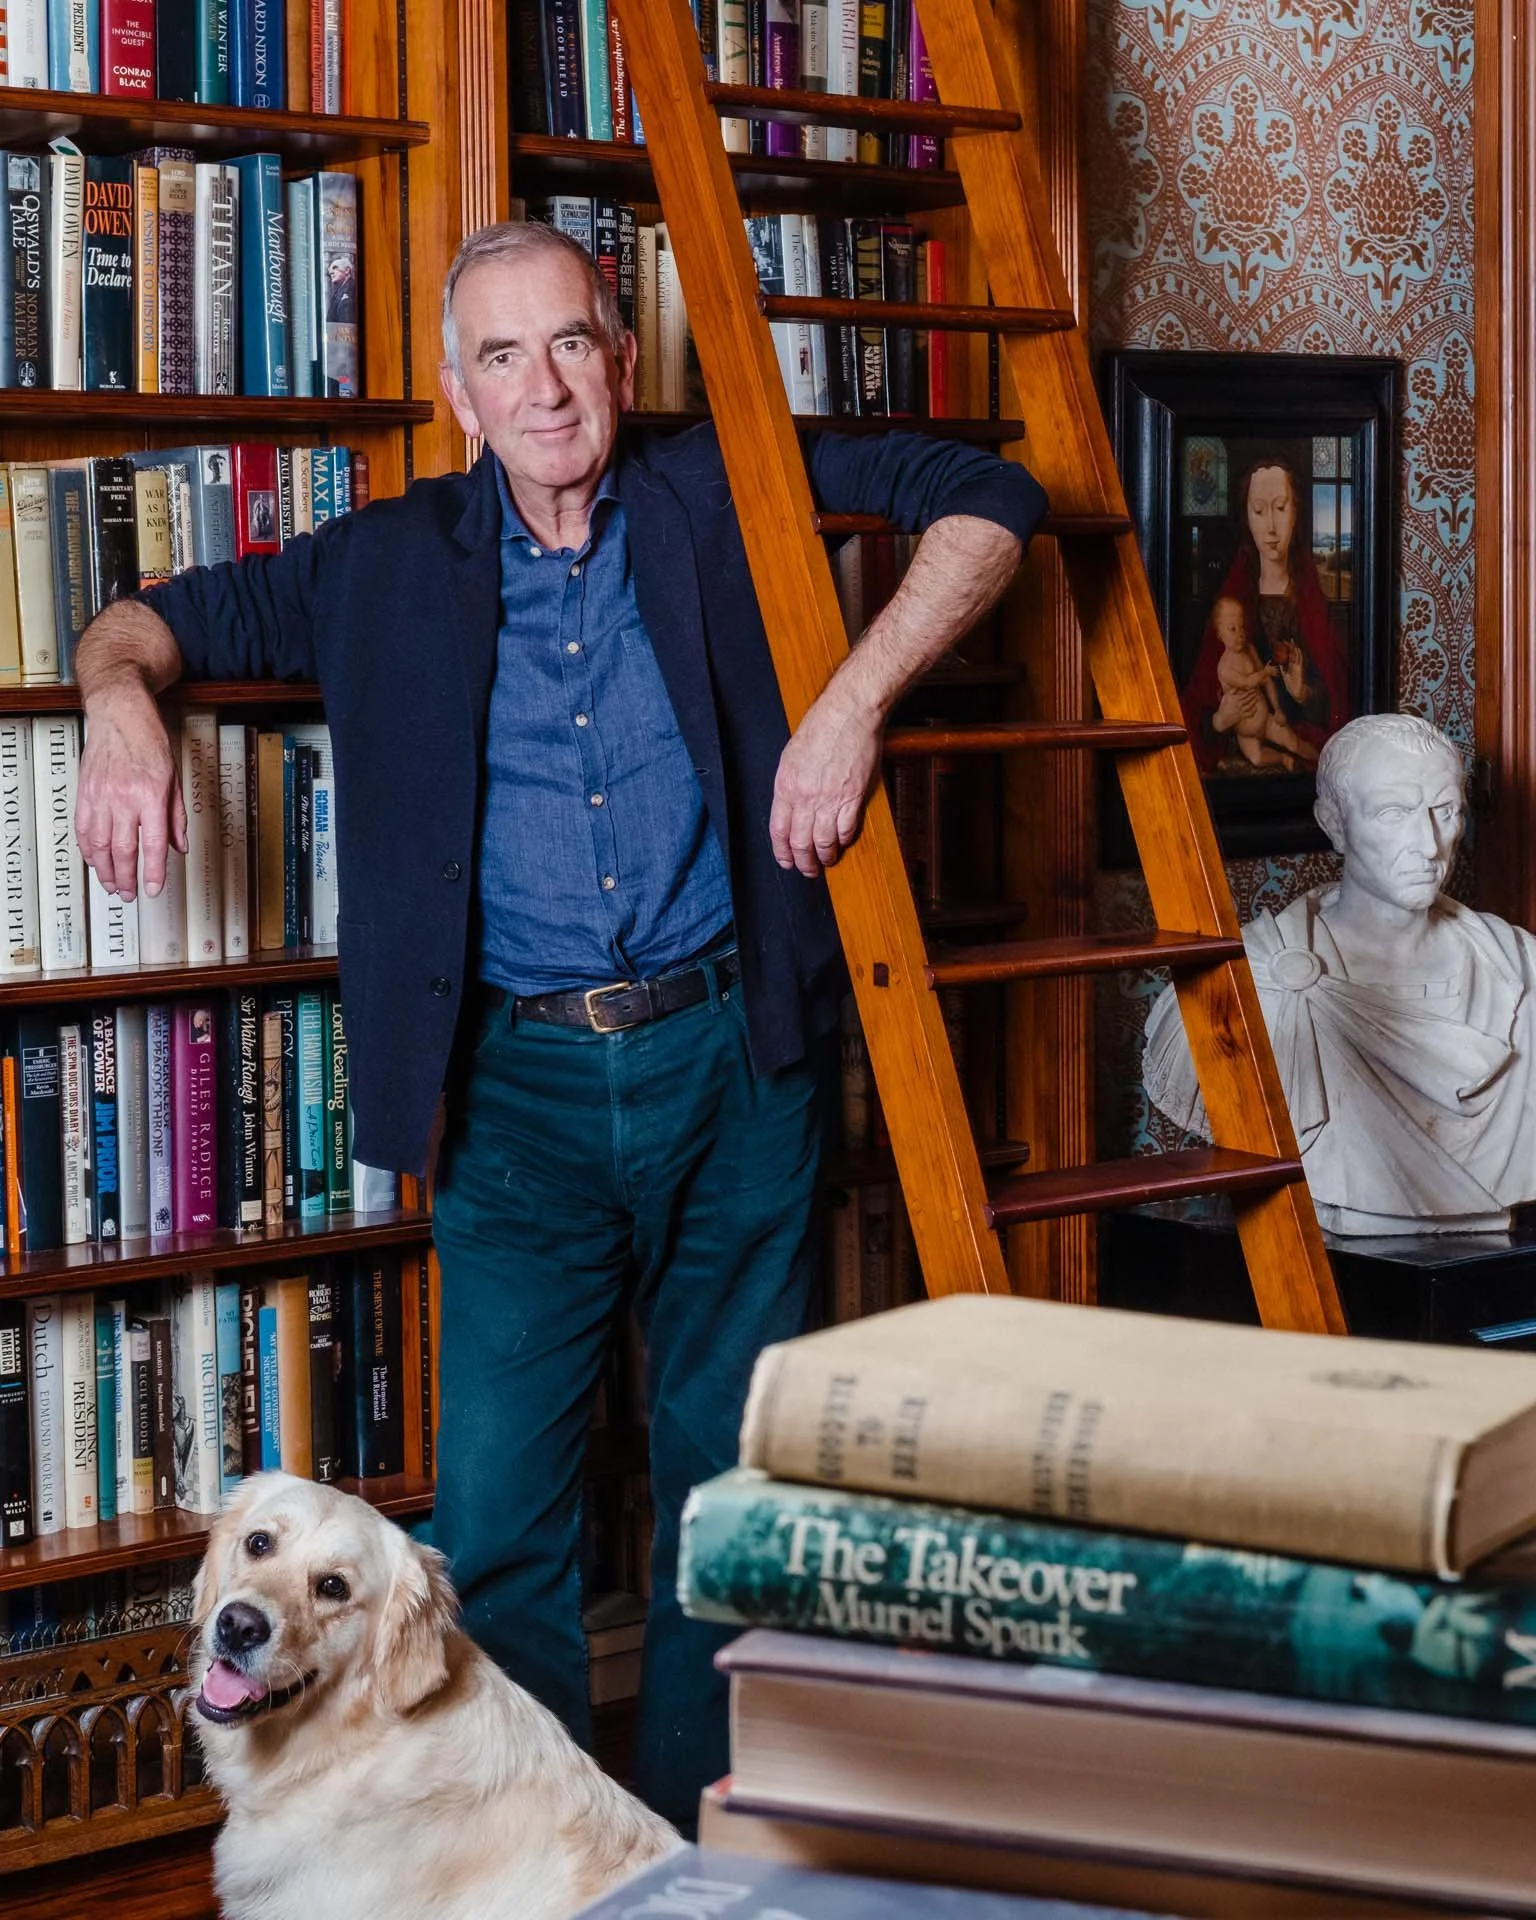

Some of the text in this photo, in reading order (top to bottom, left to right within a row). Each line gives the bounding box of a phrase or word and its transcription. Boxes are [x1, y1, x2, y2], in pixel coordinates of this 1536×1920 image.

[73, 3, 85, 54] PRESIDENT
[112, 28, 152, 40] INVINCIBLE
[121, 38, 145, 47] QUEST
[126, 20, 140, 29] THE
[218, 10, 228, 73] WINTER
[113, 66, 151, 78] CONRAD
[255, 35, 267, 87] NIXON
[556, 16, 568, 97] MOOREHEAD
[774, 33, 784, 74] Andrew
[119, 78, 147, 88] BLACK
[612, 52, 626, 138] The Autobiography
[63, 161, 80, 260] DAVID OWEN
[86, 181, 132, 209] DAVID
[622, 212, 632, 223] The
[10, 204, 29, 248] TALE
[23, 195, 40, 288] OSWALD'S
[85, 209, 131, 237] OWEN
[142, 208, 153, 266] ANSWER
[212, 197, 234, 299] TITAN
[624, 244, 630, 253] of
[792, 232, 803, 254] The
[87, 247, 131, 267] Time to
[87, 267, 132, 288] Declare
[143, 269, 153, 290] TO
[266, 208, 288, 324] Marlborough
[622, 254, 632, 264] C.P.
[638, 276, 649, 315] Expedition
[15, 292, 26, 358] MAILER
[27, 294, 38, 358] NORMAN
[143, 291, 154, 353] HISTORY
[223, 318, 231, 341] RON
[66, 490, 78, 514] THE
[145, 489, 165, 499] WAR
[281, 454, 292, 541] PAUL WEBSTER
[301, 491, 309, 513] Berg
[314, 455, 328, 502] MAX
[146, 504, 159, 512] AS
[146, 518, 168, 528] KNEW
[155, 532, 164, 541] IT
[50, 724, 65, 775] THE
[190, 738, 203, 813] PICASSO
[1, 726, 22, 900] THE YOUNGER
[218, 762, 235, 848] PICASSO
[314, 790, 329, 832] ROMAN
[52, 784, 71, 897] YOUNGER
[301, 829, 310, 852] Elder
[108, 905, 125, 957] PITT
[67, 1035, 78, 1049] THE
[151, 1011, 162, 1039] THE
[303, 995, 323, 1106] PETER RAWLINSON
[68, 1051, 79, 1070] SPIN
[94, 1019, 106, 1092] OF POWER
[104, 1015, 115, 1094] A BALANCE
[151, 1040, 163, 1099] PEACOCK
[238, 995, 258, 1187] Sir Walter Ralegh John Winton
[327, 1003, 350, 1171] Lord Reading DENIS JUDD
[70, 1109, 81, 1133] DIARY
[153, 1102, 164, 1158] THRONE
[191, 1067, 199, 1186] DIARIES 1980-2001
[200, 1053, 212, 1199] GILES RADICE
[95, 1101, 118, 1194] JIM PRIOR
[67, 1153, 79, 1208] LANCE PRICE
[313, 1296, 329, 1304] HALL
[373, 1271, 383, 1357] THE SIEVE OF TIME
[1, 1331, 14, 1373] AMERICA
[33, 1304, 55, 1505] Dutch EDMUND MORRIS
[114, 1368, 124, 1413] Kingdom
[139, 1364, 148, 1400] CECIL
[200, 1353, 218, 1450] RICHELIEU
[263, 1356, 272, 1432] NICHOLAS RIDLEY
[372, 1367, 382, 1421] Leni Riefenstahl
[380, 1379, 388, 1411] Memoirs
[73, 1381, 88, 1470] PRESIDENT
[87, 1399, 98, 1463] ACTING
[139, 1402, 148, 1452] RHODES
[3, 1500, 27, 1509] GARRY
[6, 1507, 27, 1516] WILLS
[774, 1513, 1138, 1616] The Takeover
[813, 1580, 1092, 1659] Muriel Spark
